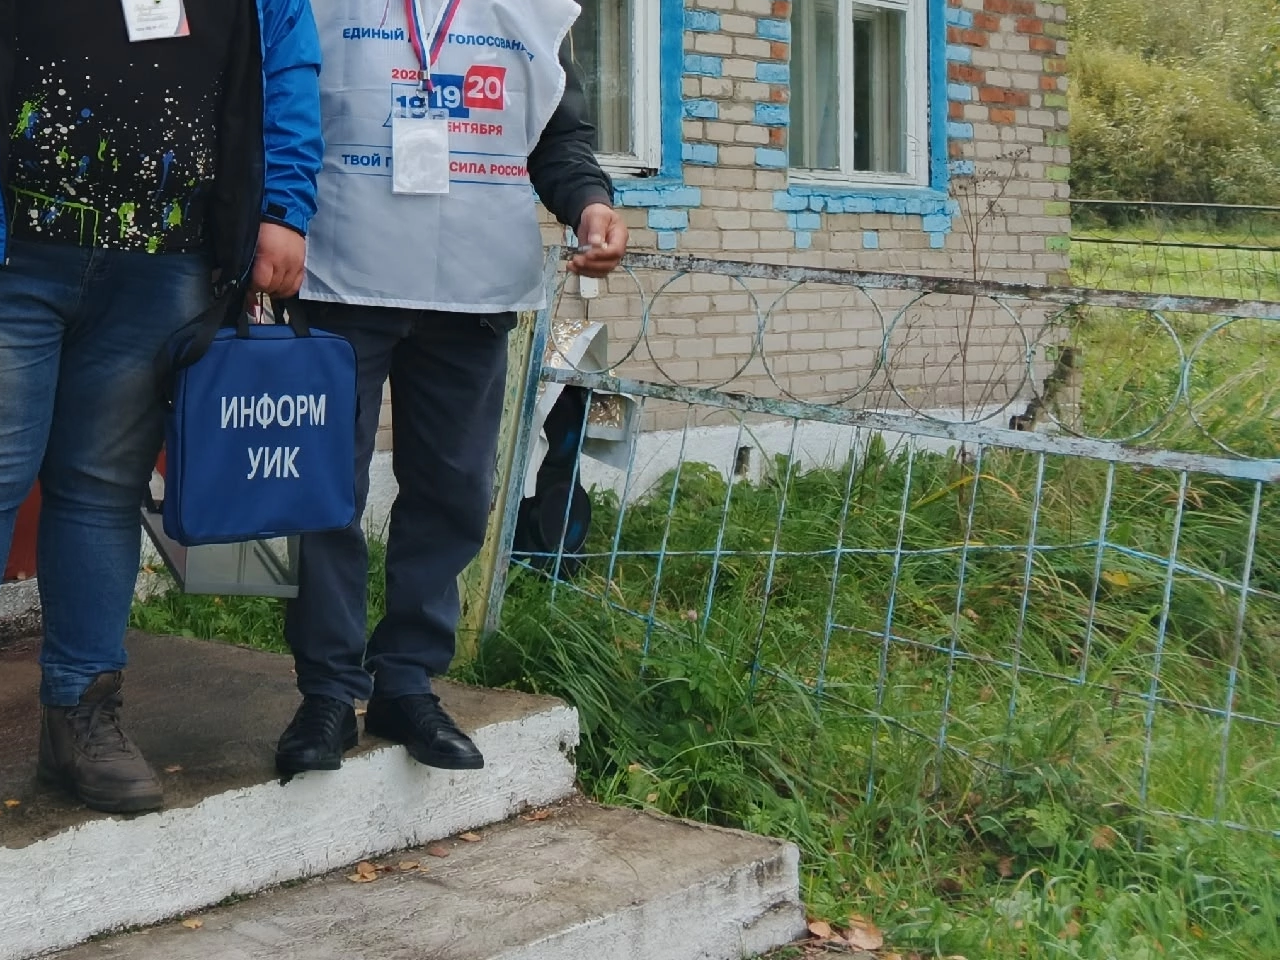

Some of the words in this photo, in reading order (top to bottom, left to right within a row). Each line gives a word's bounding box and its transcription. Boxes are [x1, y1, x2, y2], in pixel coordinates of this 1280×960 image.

[343, 27, 404, 41] ЕДИНЫЙ
[433, 85, 461, 108] 19
[467, 75, 501, 99] 20
[448, 121, 503, 136] ЕНТЯБРЯ
[342, 153, 381, 167] ТВОЙ
[449, 161, 487, 174] СИЛА
[220, 392, 326, 429] ИНФОРМ
[246, 446, 300, 480] УИК
